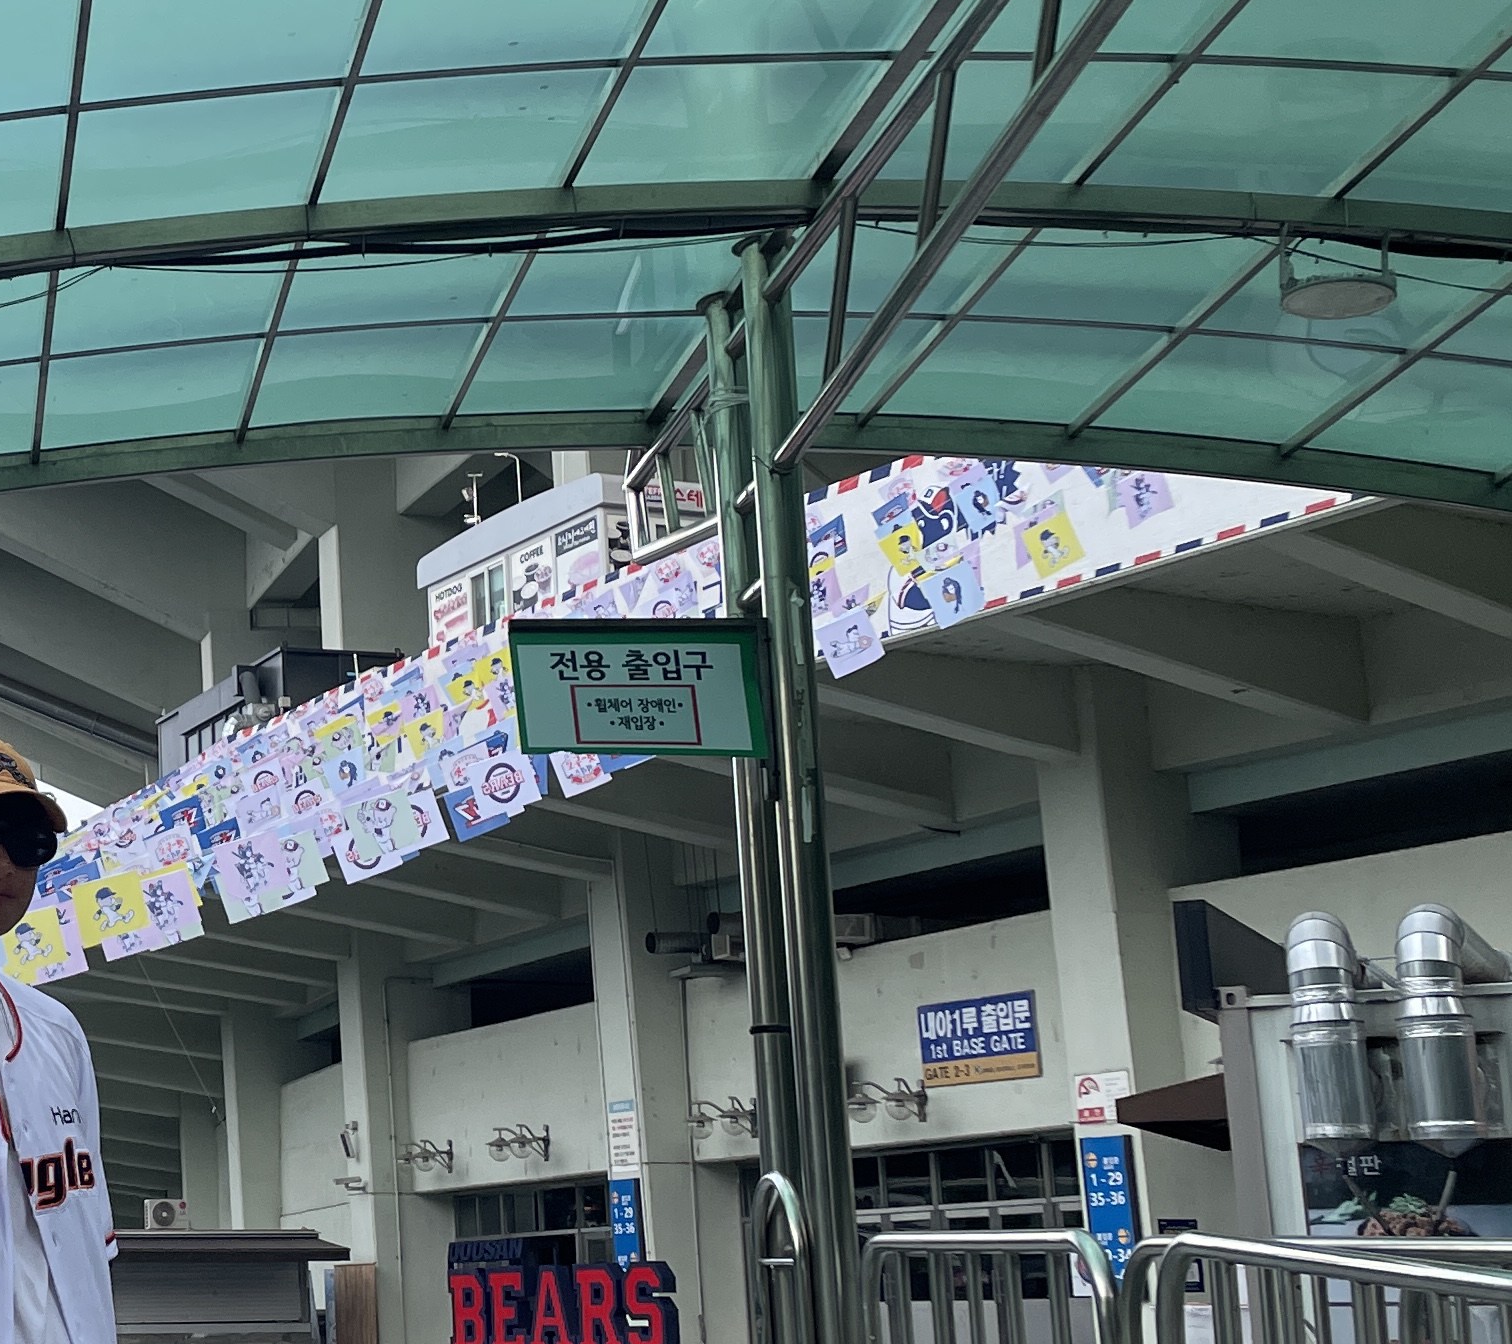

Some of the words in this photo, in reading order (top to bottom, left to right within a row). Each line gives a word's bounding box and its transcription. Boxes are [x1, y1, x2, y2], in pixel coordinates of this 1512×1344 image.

[520, 545, 544, 564] COFFEE
[435, 583, 462, 602] HOTDOG
[550, 650, 610, 681] 전용
[622, 649, 714, 681] 출입구
[594, 698, 632, 713] 휠체어
[637, 698, 677, 713] 장애인
[618, 716, 656, 730] 재입장
[920, 1006, 979, 1040] 내야1루
[980, 999, 1031, 1034] 출입문
[930, 1042, 948, 1059] 1st
[952, 1037, 986, 1056] BASE
[990, 1032, 1026, 1052] GATE
[924, 1066, 950, 1080] GATE
[1090, 1191, 1126, 1206] 35-36
